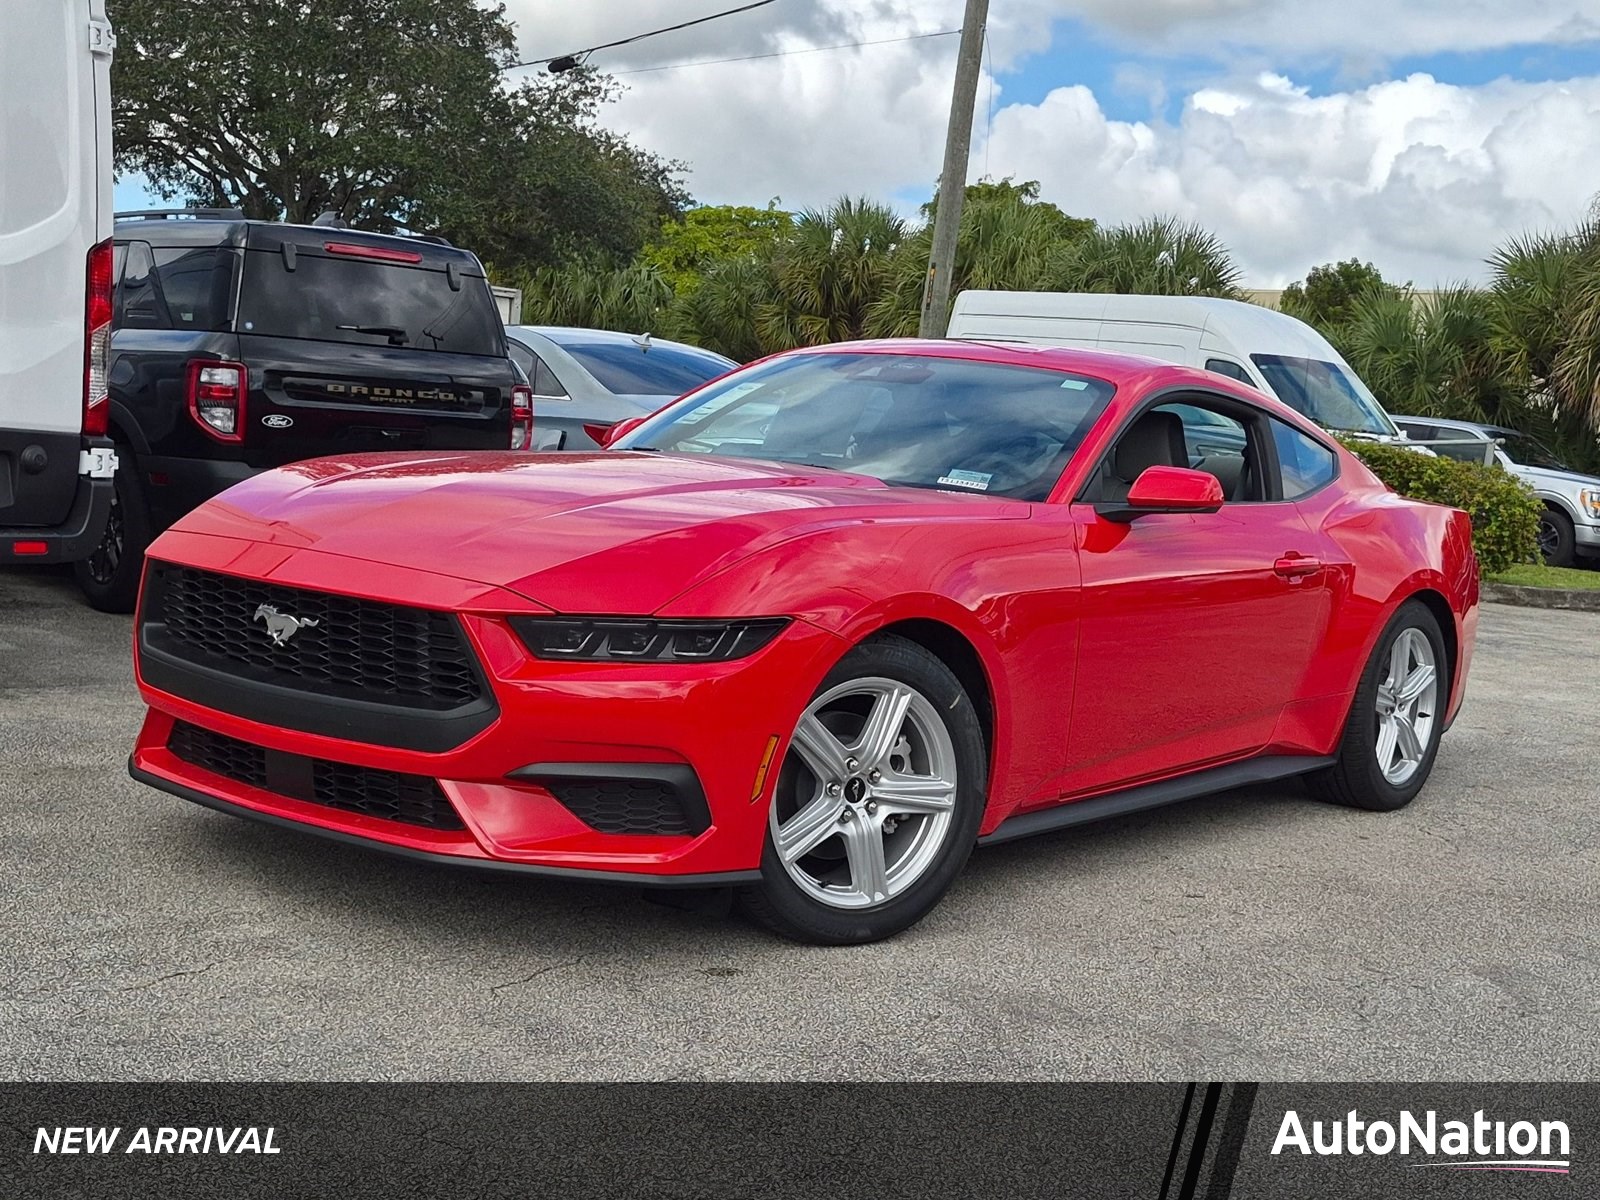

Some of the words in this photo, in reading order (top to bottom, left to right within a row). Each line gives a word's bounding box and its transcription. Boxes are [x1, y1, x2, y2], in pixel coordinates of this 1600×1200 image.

[327, 384, 455, 400] BRONCO
[369, 396, 416, 404] SPORT
[265, 416, 290, 427] Ford
